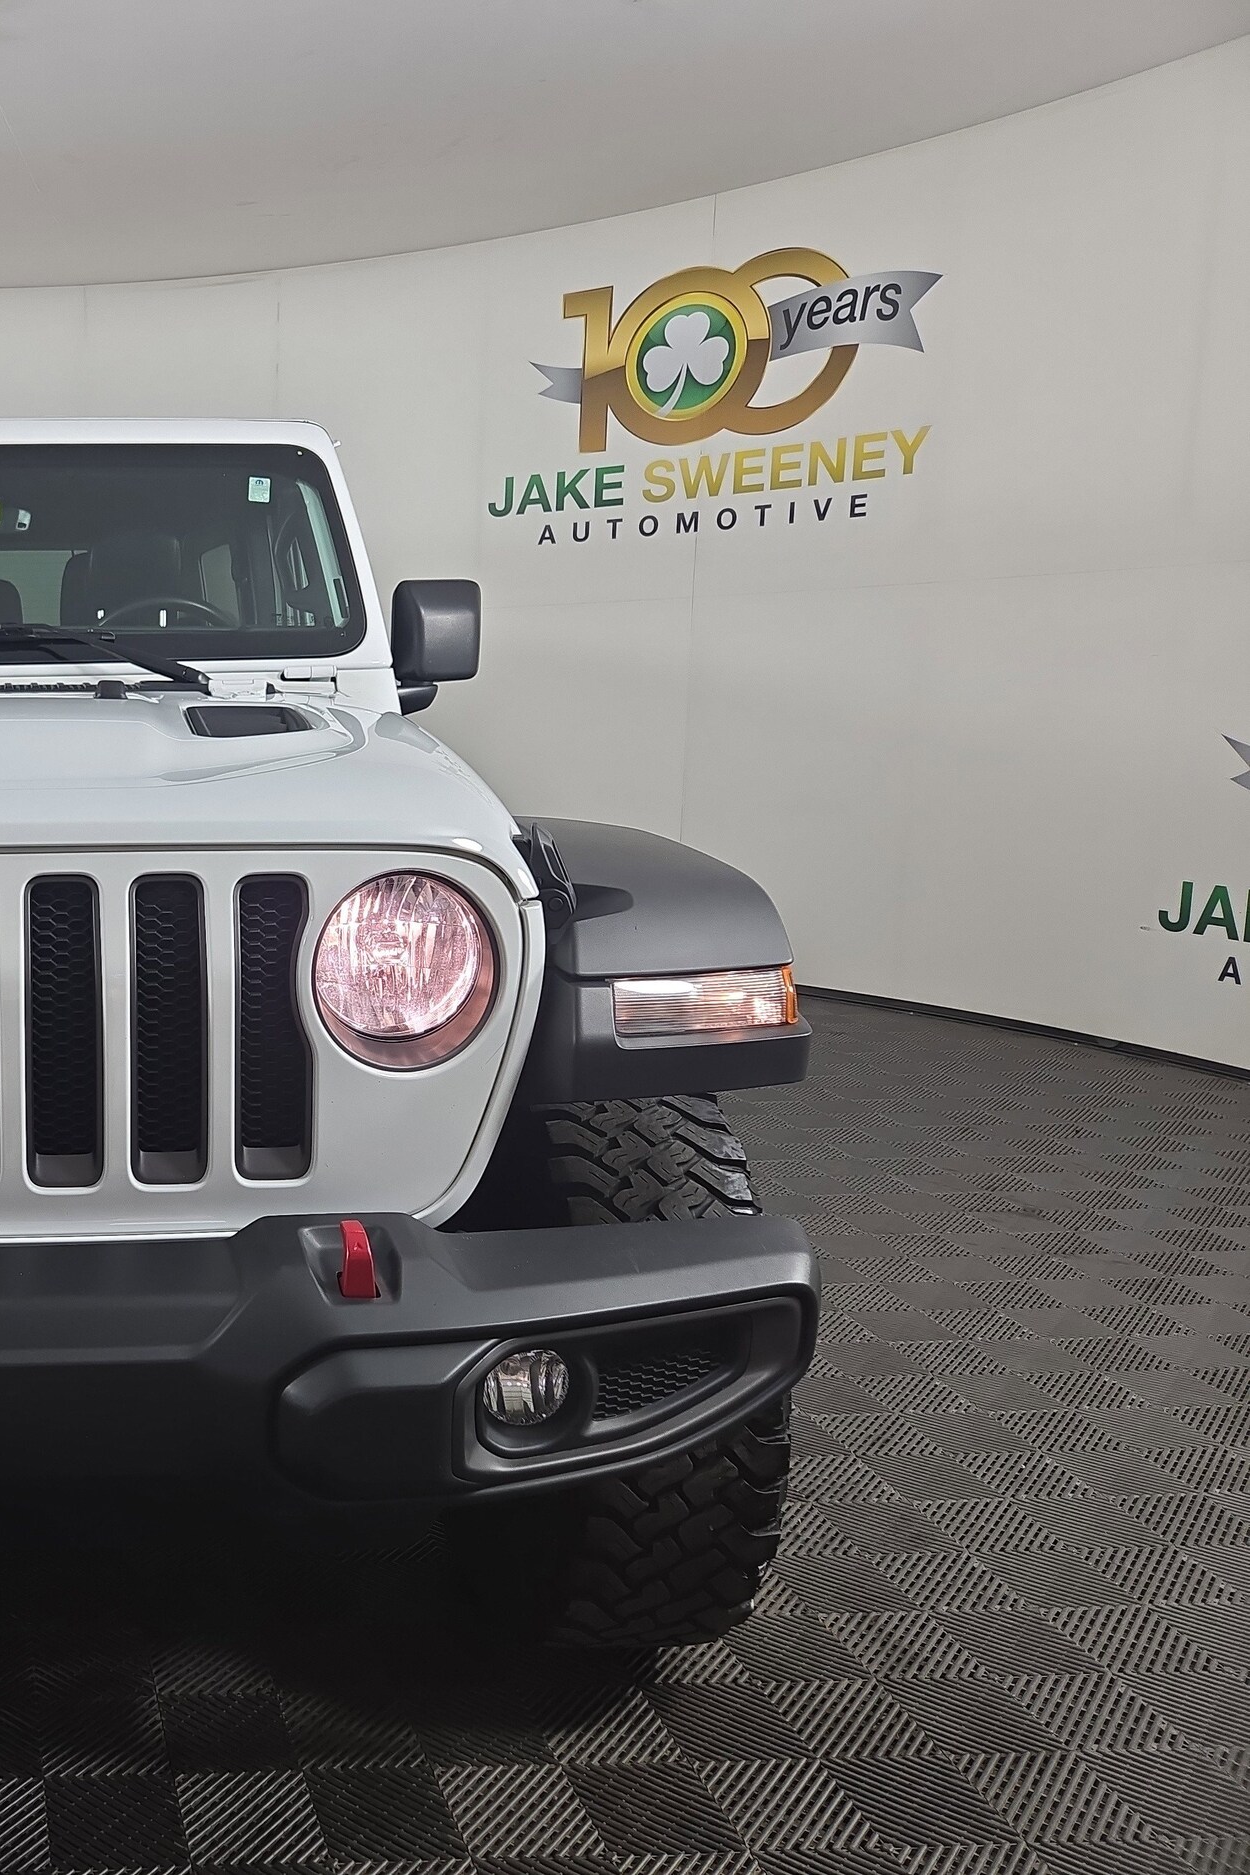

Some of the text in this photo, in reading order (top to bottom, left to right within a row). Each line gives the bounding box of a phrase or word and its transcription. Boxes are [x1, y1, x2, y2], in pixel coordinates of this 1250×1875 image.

[563, 247, 858, 453] 100
[779, 281, 902, 350] years
[488, 425, 932, 518] JAKE SWEENEY
[538, 493, 868, 545] AUTOMOTIVE
[1158, 880, 1250, 942] JA
